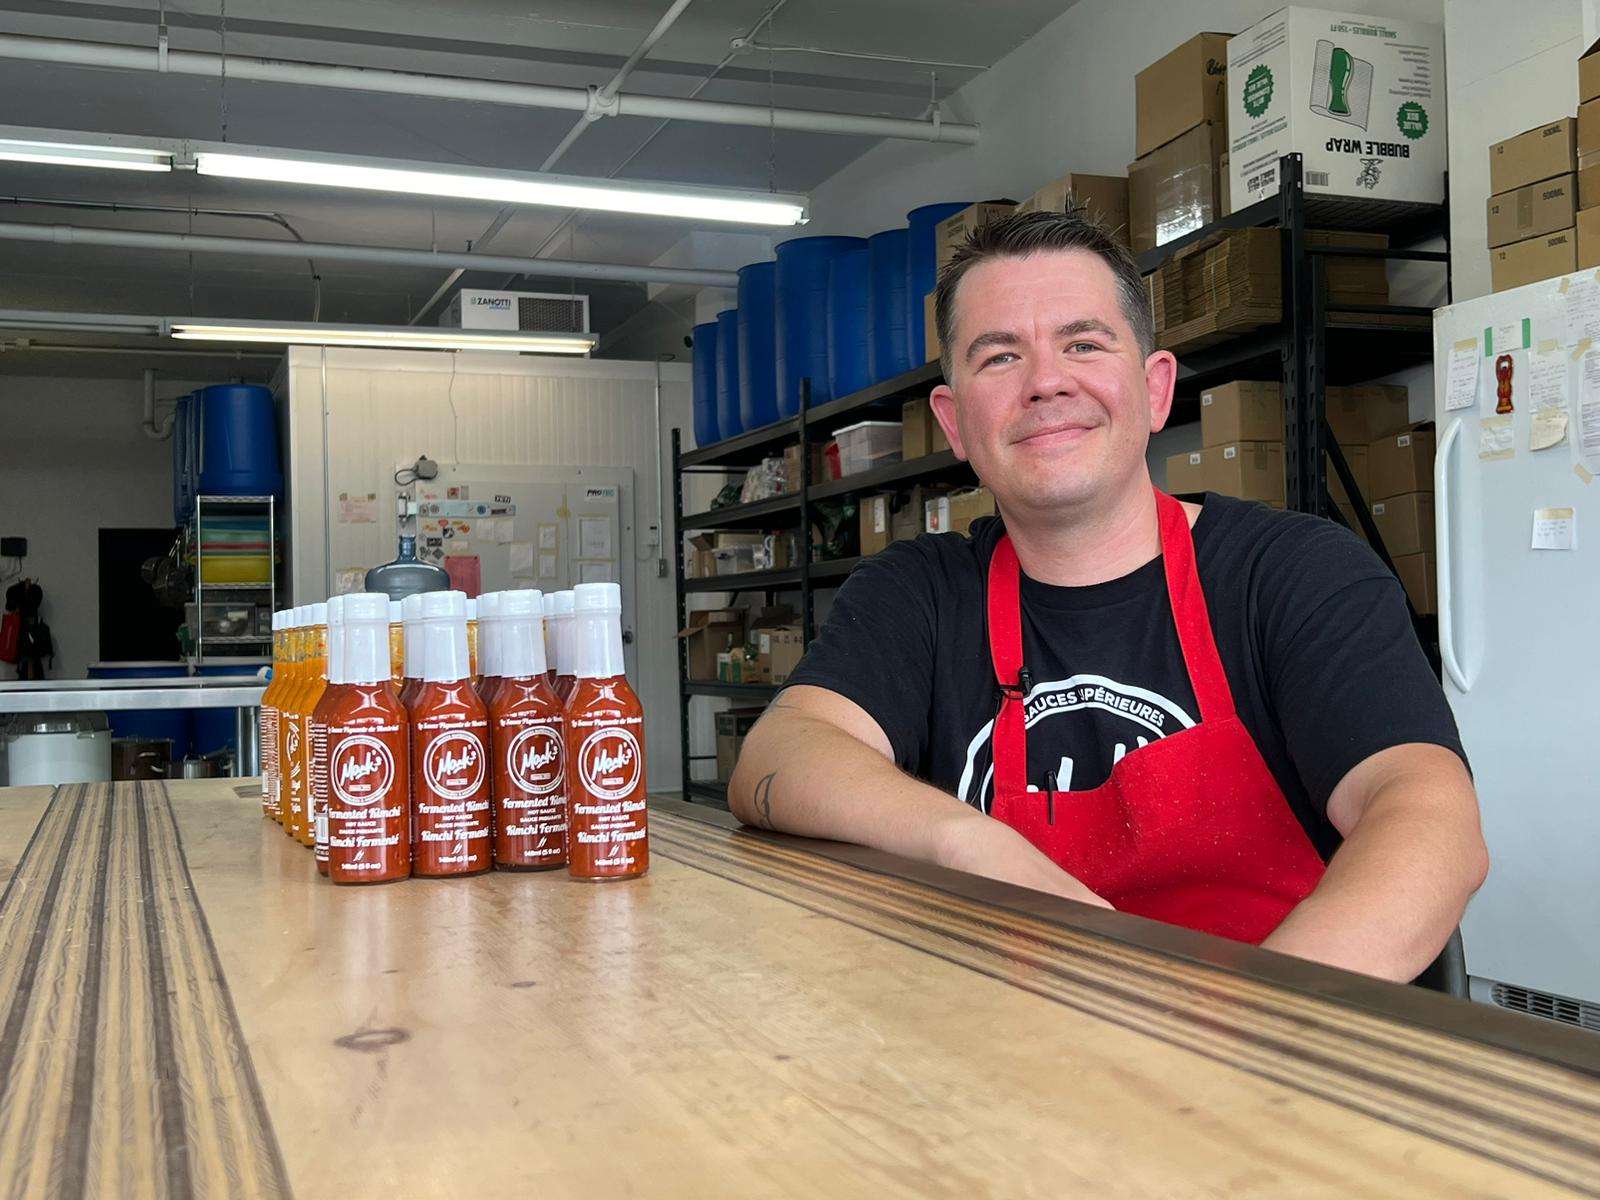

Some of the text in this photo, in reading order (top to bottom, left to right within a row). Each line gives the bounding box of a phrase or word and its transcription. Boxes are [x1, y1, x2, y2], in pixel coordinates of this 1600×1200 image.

[1407, 112, 1420, 120] BOX
[1403, 121, 1423, 131] VALUE
[1326, 138, 1410, 158] BUBBLE WRAP
[476, 297, 511, 307] ZANOTTI
[1078, 687, 1165, 727] PÉRIEURES
[418, 802, 465, 814] Fermented
[502, 796, 548, 809] Fermented
[574, 802, 621, 815] Fermented
[369, 805, 401, 818] Kimchi
[421, 830, 454, 842] Kimchi
[506, 824, 538, 836] Kimchi
[577, 831, 610, 844] Kimchi
